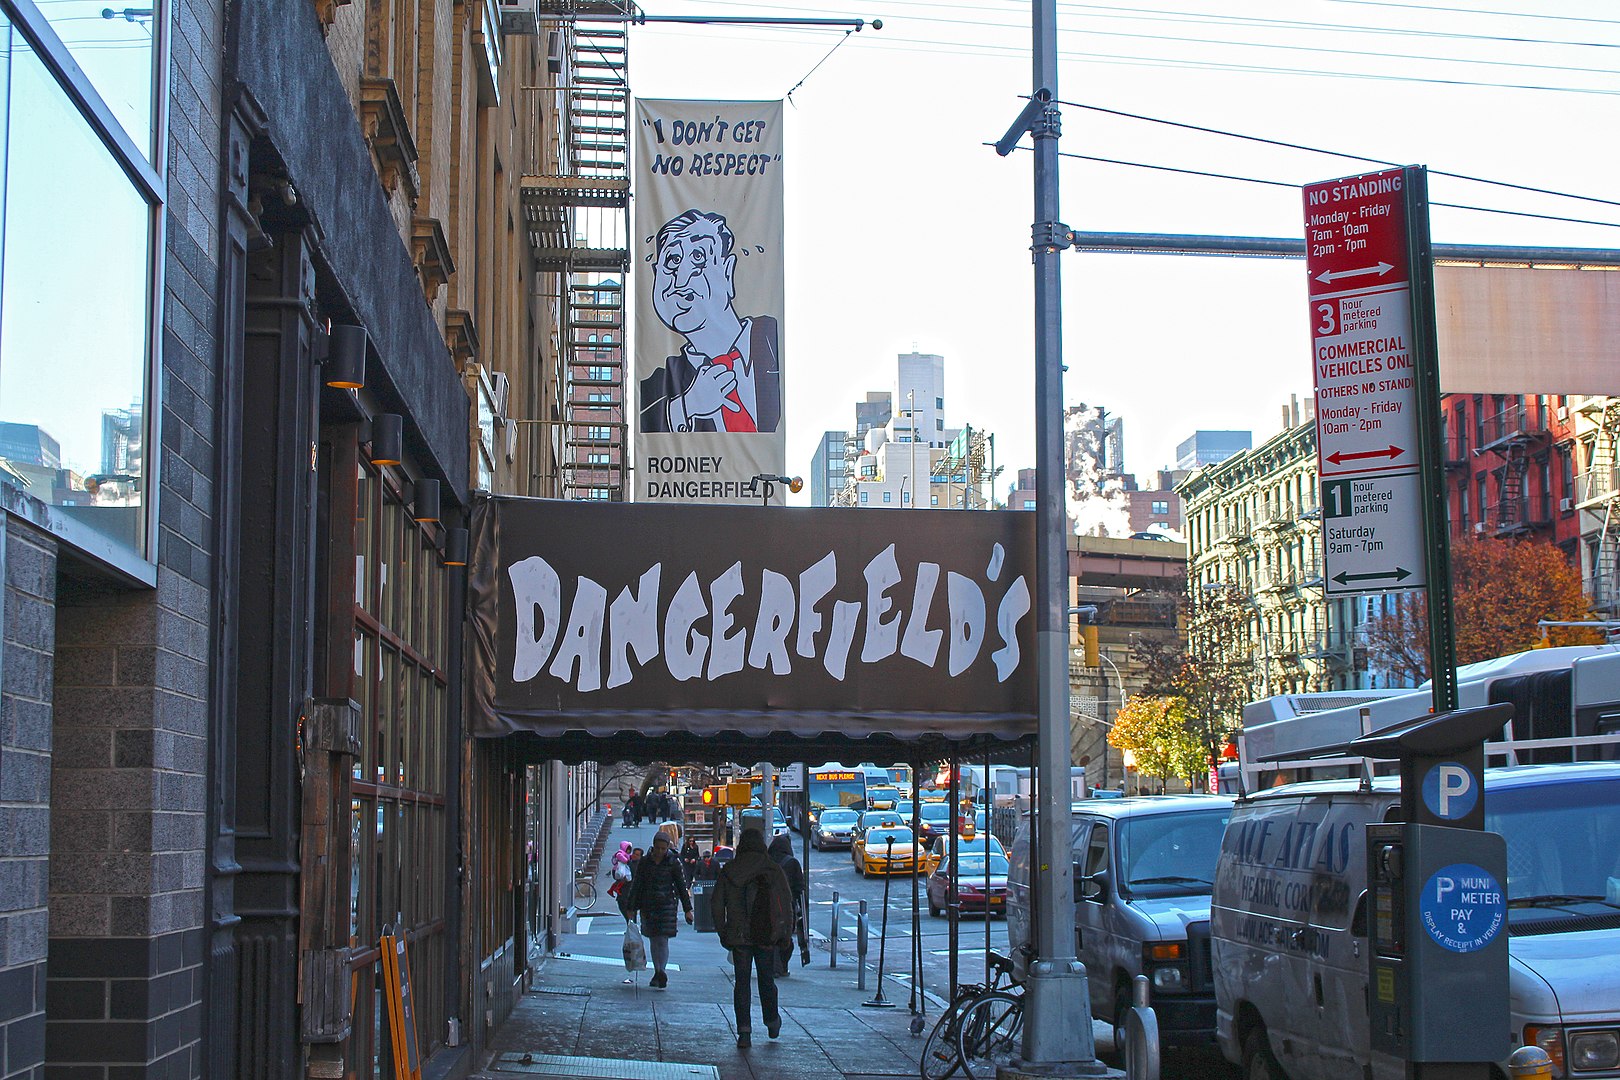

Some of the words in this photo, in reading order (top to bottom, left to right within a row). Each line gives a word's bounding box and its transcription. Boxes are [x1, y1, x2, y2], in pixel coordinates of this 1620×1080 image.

[672, 115, 729, 146] DON'T
[732, 120, 766, 143] GET
[651, 154, 684, 177] NO
[688, 152, 782, 177] RESPECT"
[1309, 189, 1329, 206] NO
[1332, 176, 1402, 202] STANDING
[1310, 211, 1349, 227] Monday
[1359, 204, 1391, 219] Friday
[1311, 228, 1333, 242] 7am
[1342, 223, 1369, 236] 10am
[1313, 244, 1335, 258] 2pm
[1344, 238, 1367, 253] 7pm
[1317, 303, 1336, 335] 3
[1342, 299, 1363, 310] hour
[1343, 306, 1381, 321] metered
[1343, 319, 1377, 333] parking
[1318, 336, 1406, 361] COMMERCIAL
[1319, 357, 1383, 379] VEHICLES
[1386, 353, 1415, 371] ONL
[1321, 384, 1359, 399] OTHERS
[1361, 382, 1376, 395] NO
[1378, 378, 1414, 392] STANDI
[1321, 405, 1361, 420] Monday
[1371, 400, 1403, 415] Friday
[1323, 422, 1349, 435] 10am
[1359, 418, 1382, 432] 2pm
[647, 456, 723, 474] RODNEY
[647, 481, 775, 499] DANGERFIELD
[1330, 484, 1342, 516] 1
[1353, 482, 1375, 492] hour
[1353, 490, 1393, 503] metered
[1354, 502, 1389, 516] parking
[1328, 526, 1376, 540] Saturday
[1329, 542, 1352, 555] 9am
[1360, 539, 1384, 554] 7pm
[507, 541, 1032, 693] DANGERFIELD'S
[1439, 765, 1471, 816] P
[1274, 821, 1355, 874] ATLAS
[1241, 876, 1282, 908] HEATING
[1284, 882, 1313, 912] COR
[1436, 877, 1455, 904] P
[1461, 877, 1490, 890] MUNI
[1461, 892, 1501, 905] METER
[1450, 909, 1473, 921] PAY
[1424, 911, 1444, 940] DISPLAY
[1443, 937, 1473, 949] RECEIPT
[1474, 937, 1483, 947] IN
[1482, 912, 1502, 940] VEHICLE
[1457, 922, 1467, 934] &
